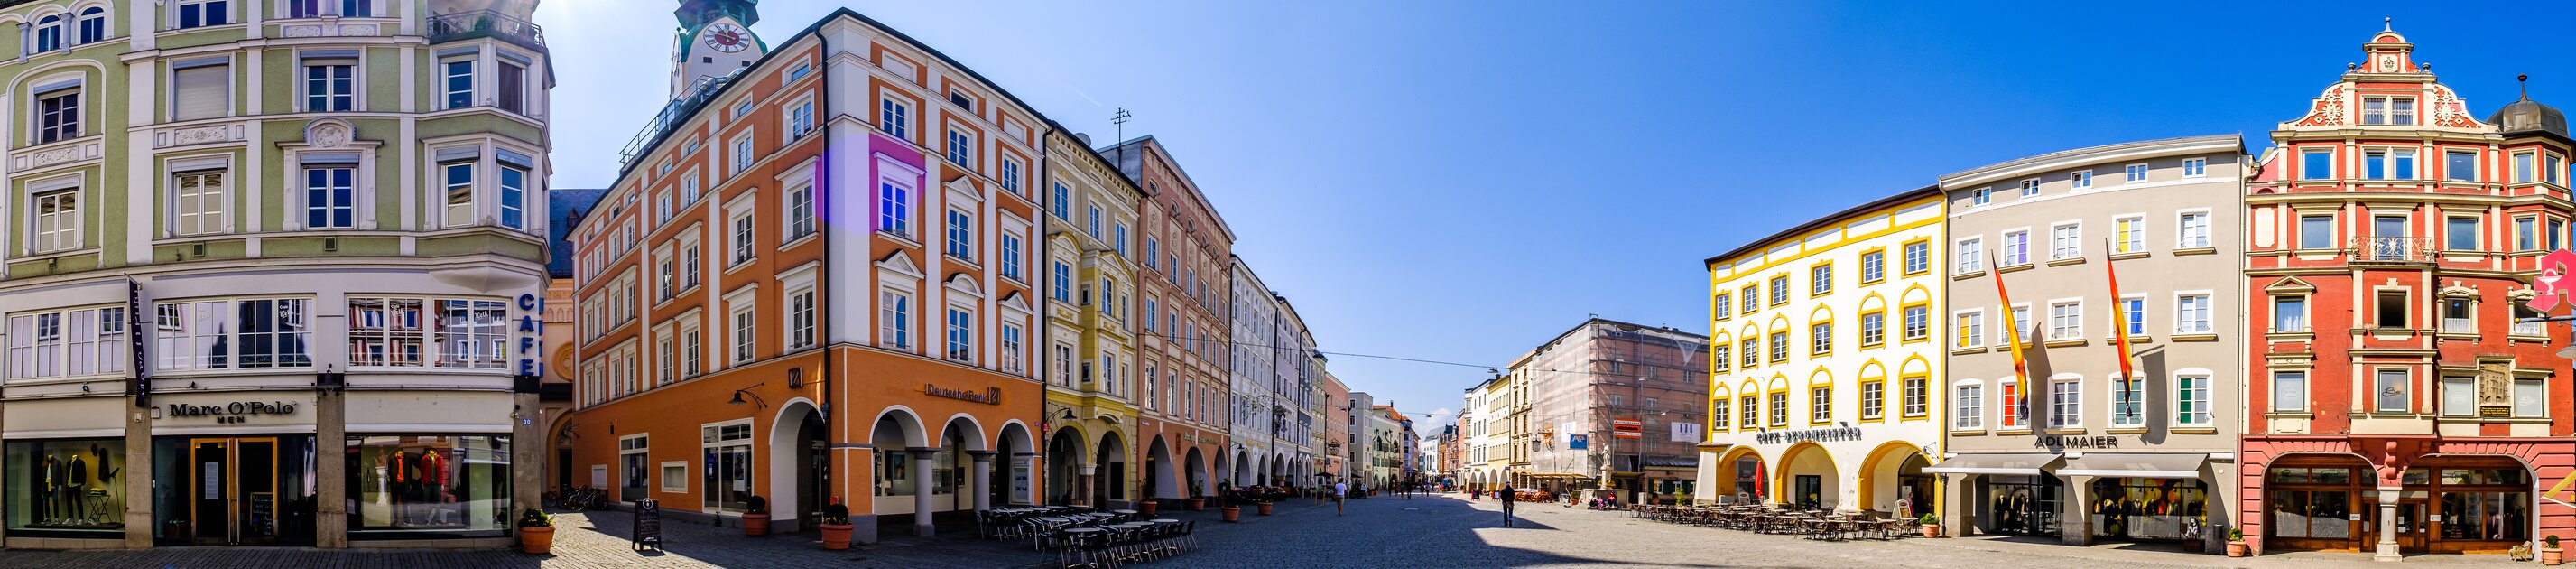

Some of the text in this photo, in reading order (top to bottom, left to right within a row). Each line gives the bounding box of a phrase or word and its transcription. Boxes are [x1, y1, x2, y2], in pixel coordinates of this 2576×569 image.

[519, 294, 535, 377] CAFE
[169, 403, 222, 416] Marc
[2034, 436, 2117, 448] ADLMAIER
